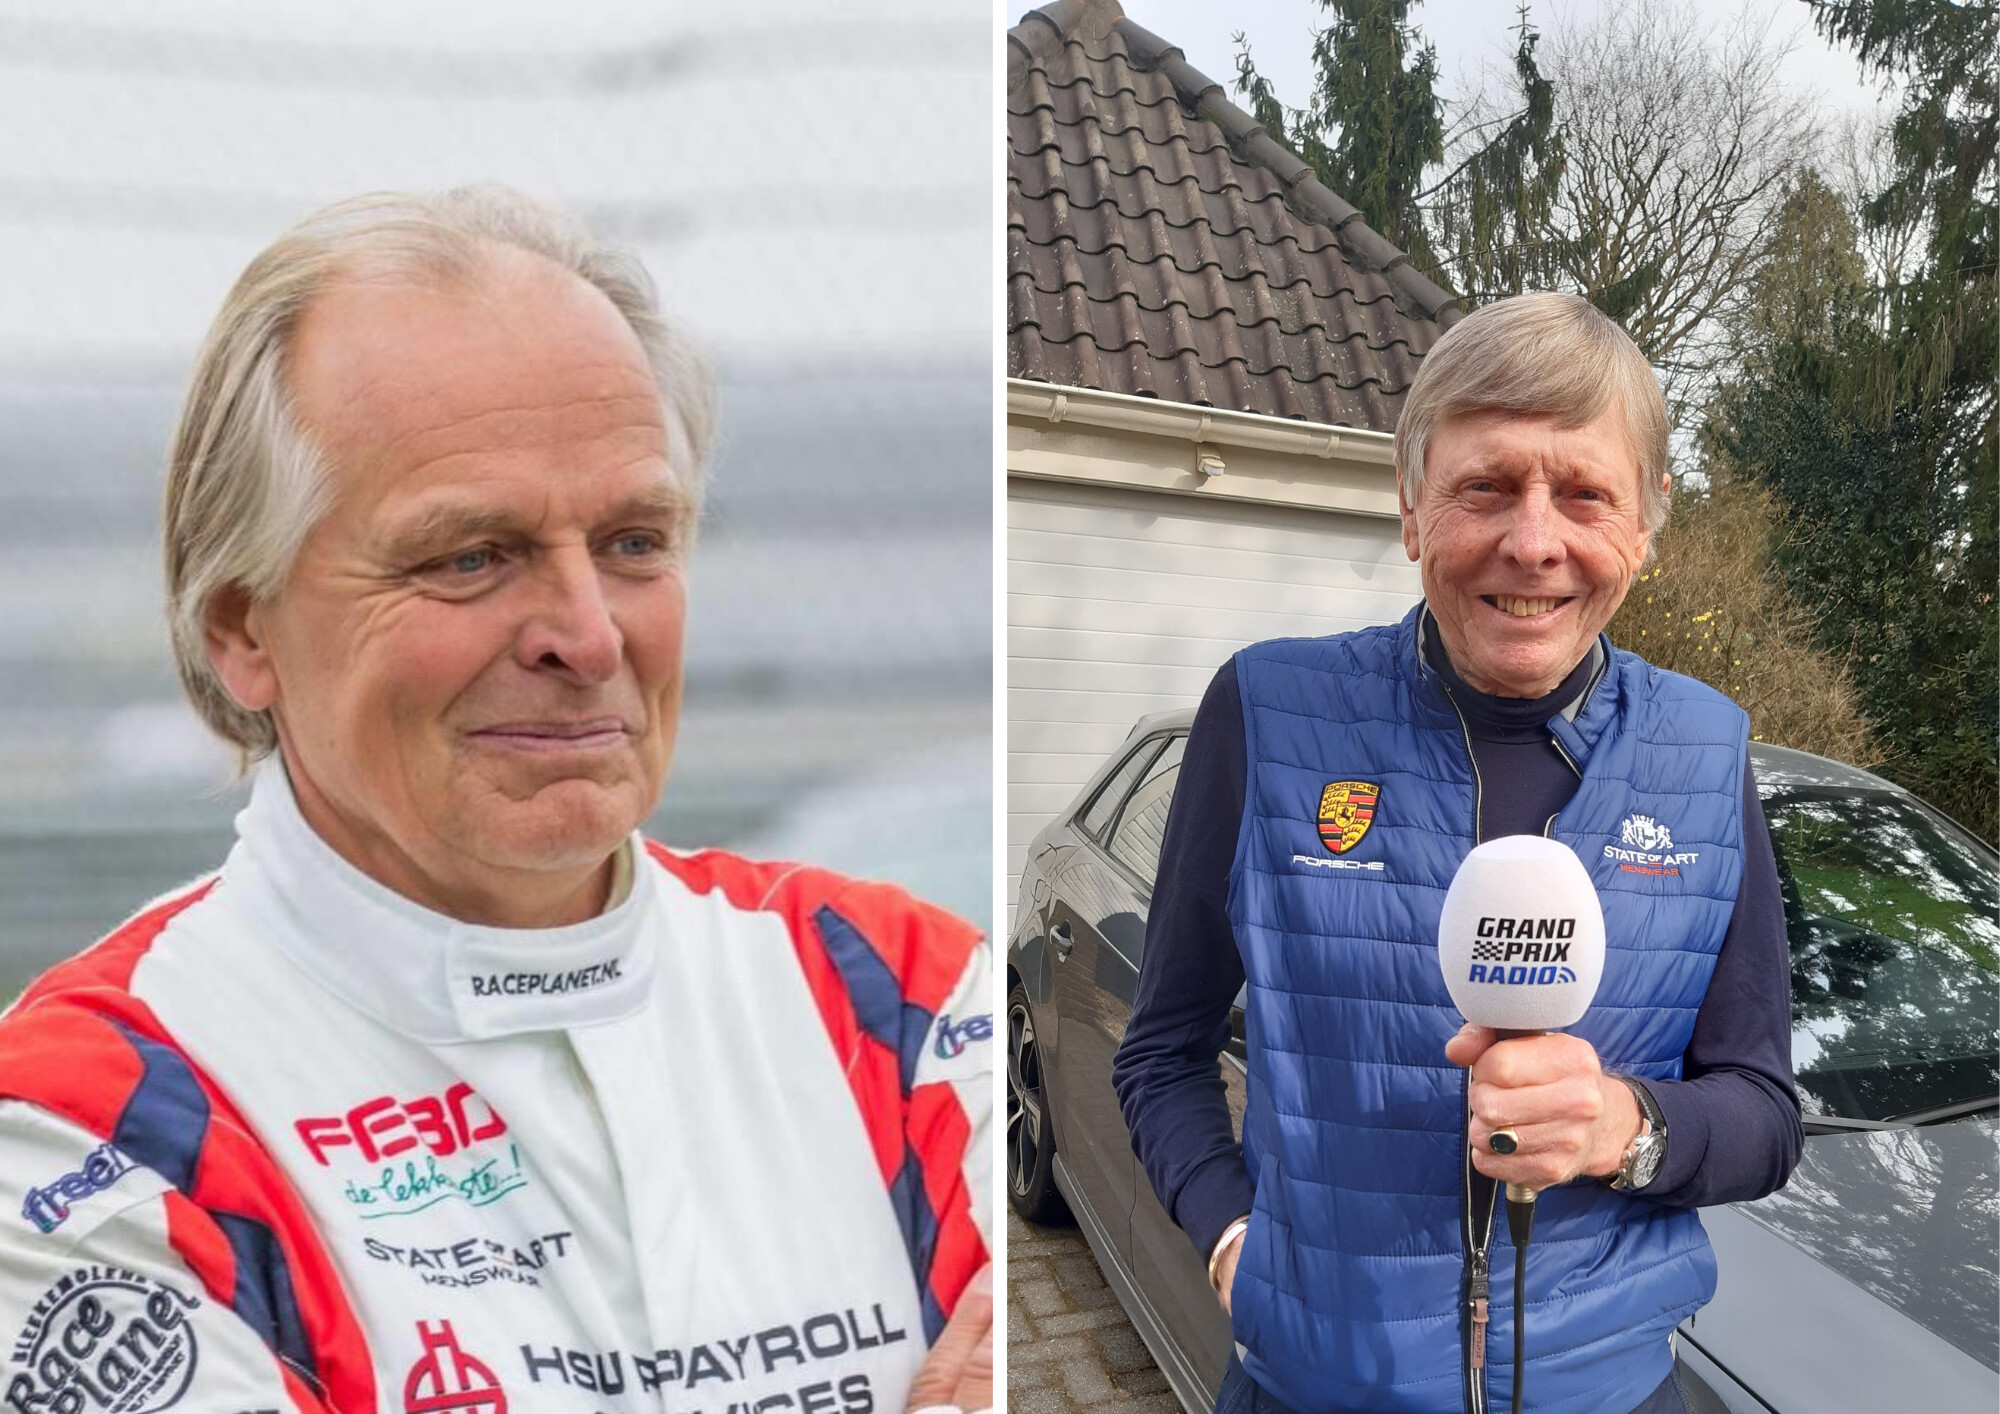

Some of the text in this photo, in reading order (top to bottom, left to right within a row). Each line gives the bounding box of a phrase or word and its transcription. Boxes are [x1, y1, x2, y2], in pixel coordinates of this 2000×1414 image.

[1326, 782, 1378, 795] PORSCHE
[1293, 854, 1385, 871] PORSCHE
[1603, 845, 1699, 866] STATE OF ART
[1620, 864, 1679, 877] MENSWEAR
[1477, 917, 1576, 939] GRAND
[1504, 942, 1571, 962] PRIX
[1469, 964, 1557, 985] RADIO
[294, 1081, 507, 1166] FEBO
[363, 1237, 486, 1270] STATE
[513, 1231, 572, 1271] ART
[5, 1295, 115, 1414] Race
[520, 1303, 907, 1396] HSU PAYROLL
